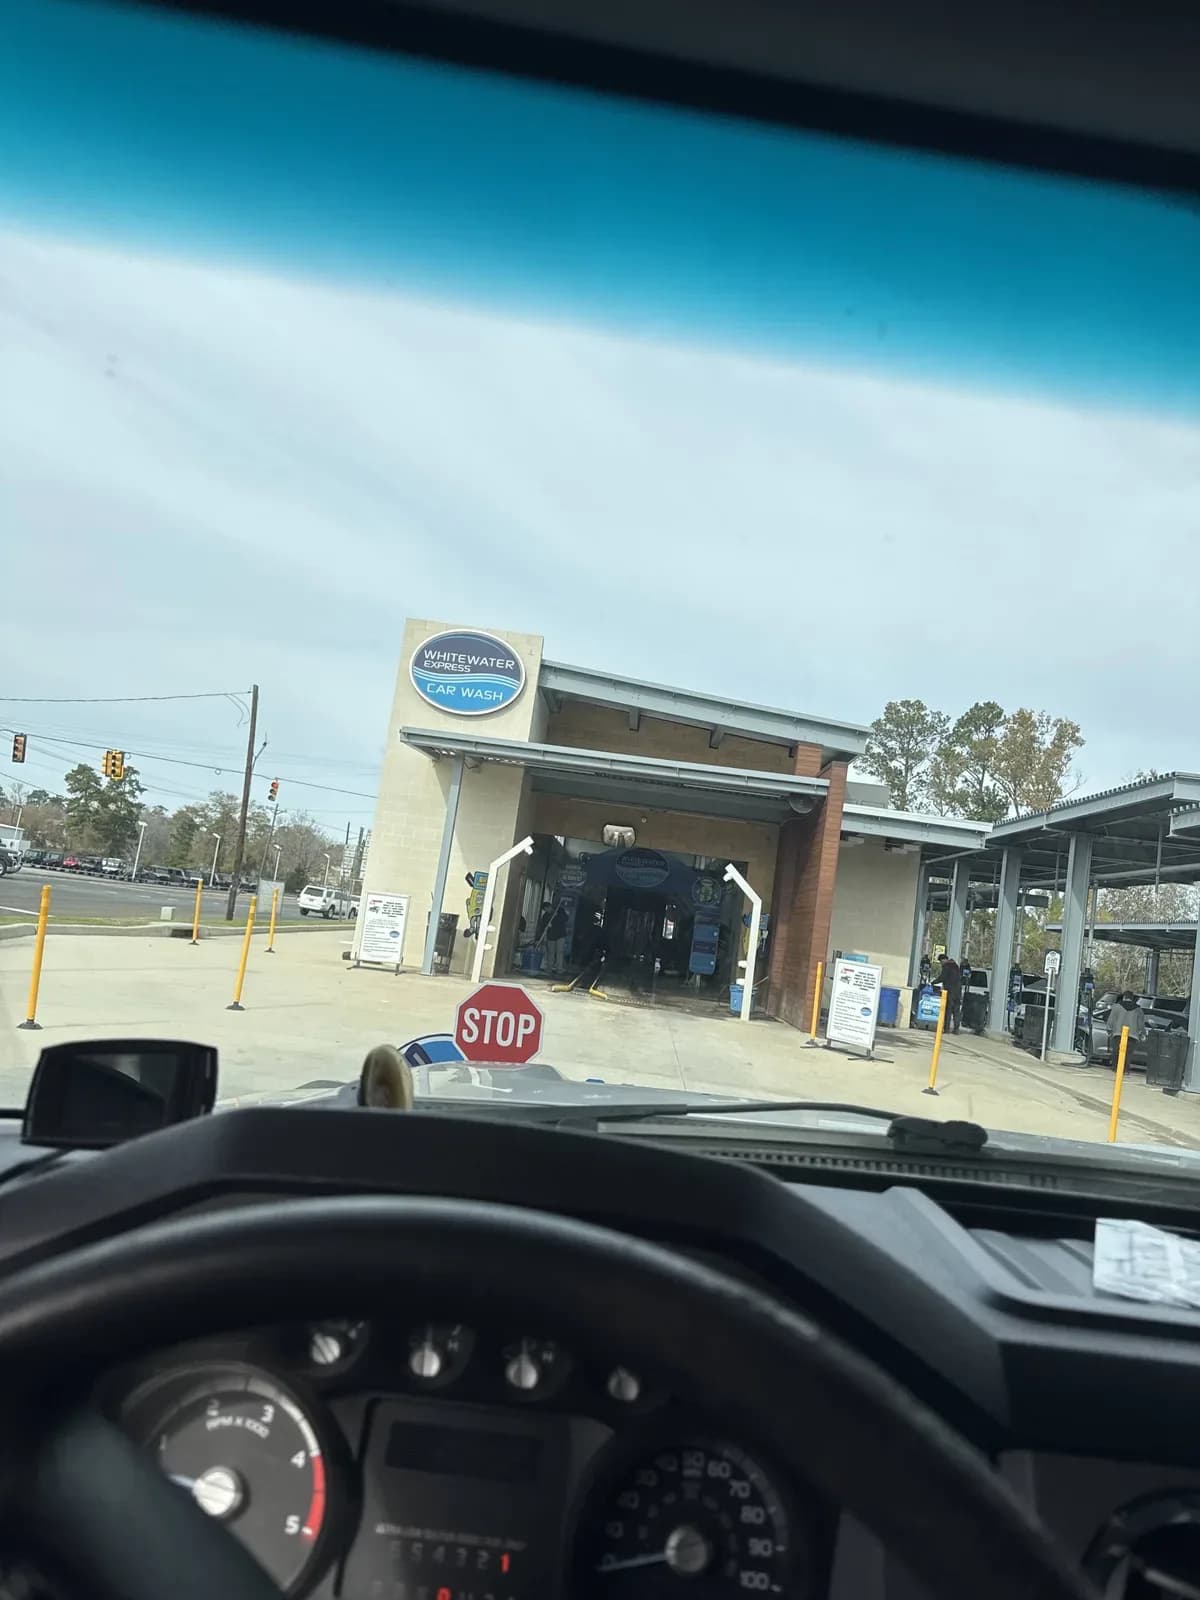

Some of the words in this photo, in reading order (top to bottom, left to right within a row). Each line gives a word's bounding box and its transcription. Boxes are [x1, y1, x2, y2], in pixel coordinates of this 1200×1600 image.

[423, 659, 471, 673] EXPRESS
[424, 649, 515, 670] WHITEWATER
[426, 682, 456, 696] CAR
[461, 687, 503, 702] WASH
[461, 1007, 536, 1048] STOP
[260, 1404, 275, 1423] 3
[290, 1450, 306, 1469] 4
[707, 1460, 732, 1480] 60
[729, 1478, 751, 1499] 70
[284, 1514, 301, 1534] 5
[740, 1504, 766, 1525] 80
[749, 1537, 774, 1558] 90
[500, 1551, 511, 1574] 1
[739, 1570, 770, 1591] 100
